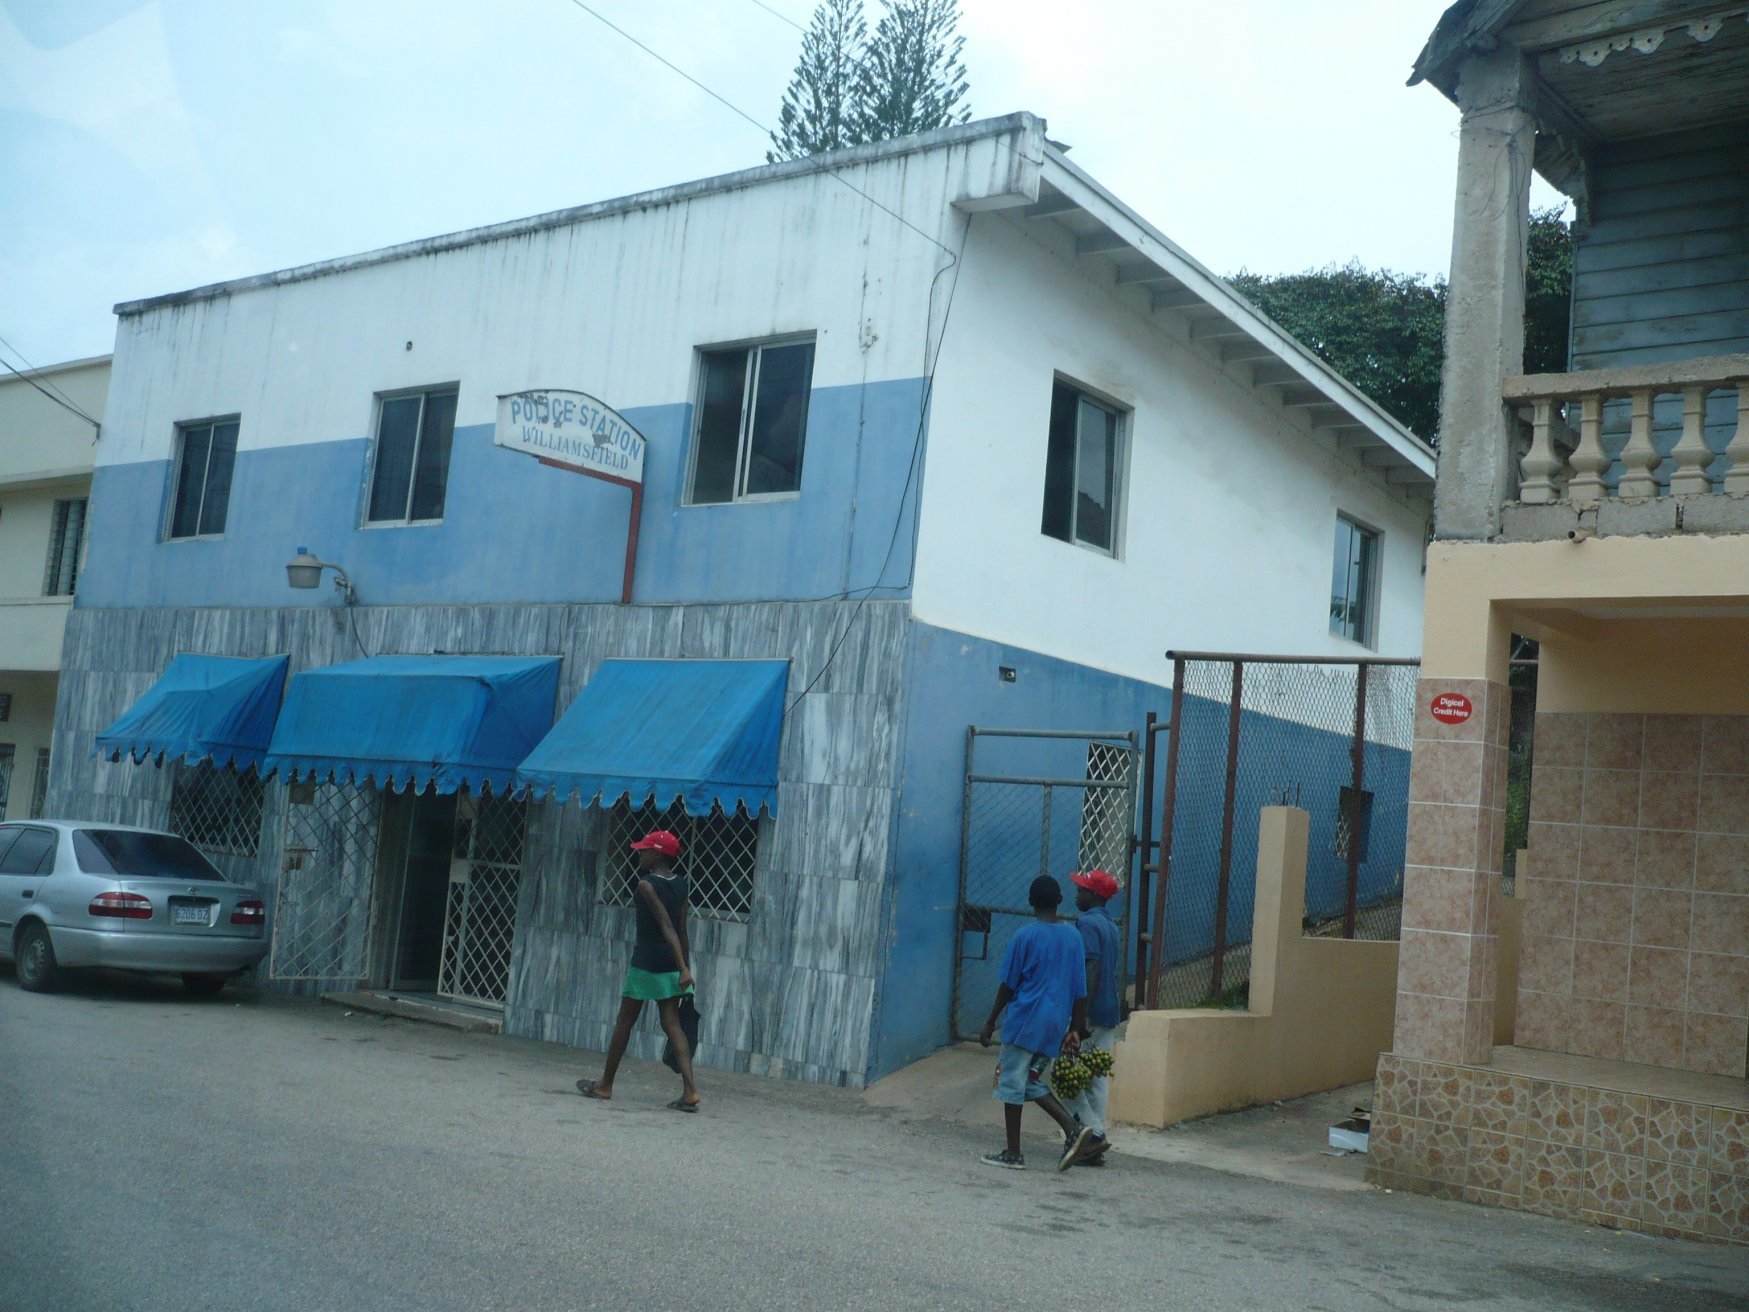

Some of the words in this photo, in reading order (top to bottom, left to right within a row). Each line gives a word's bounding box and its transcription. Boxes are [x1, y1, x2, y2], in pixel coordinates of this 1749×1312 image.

[511, 398, 574, 425] POLICE
[579, 404, 641, 461] STATION
[522, 425, 629, 470] WILLIAMSFIELD
[1433, 707, 1453, 715] Credit
[1453, 709, 1469, 717] Here
[1440, 697, 1464, 707] Digicel
